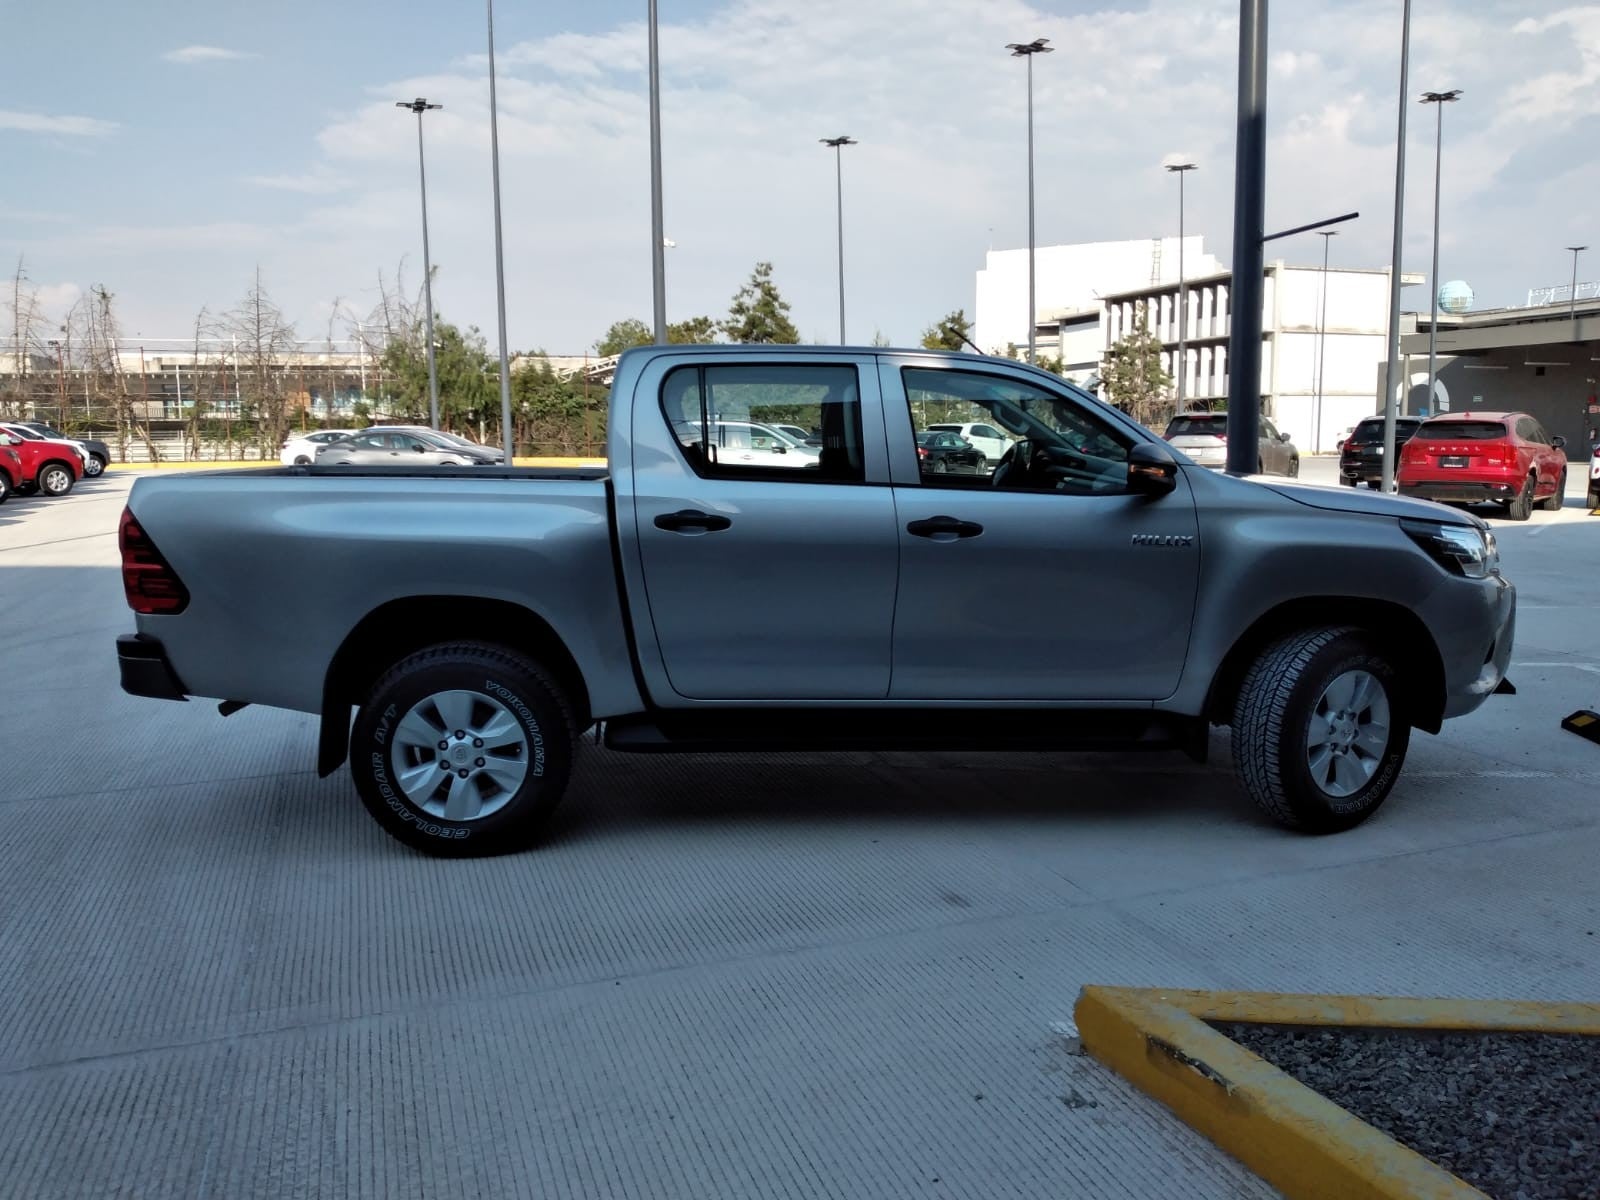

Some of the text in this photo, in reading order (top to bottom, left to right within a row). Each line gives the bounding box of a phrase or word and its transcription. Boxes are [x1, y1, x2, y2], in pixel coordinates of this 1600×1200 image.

[1131, 534, 1193, 547] HILUX
[371, 703, 471, 840] GEOLANDAR A/T
[486, 680, 545, 777] YOKOHAMA
